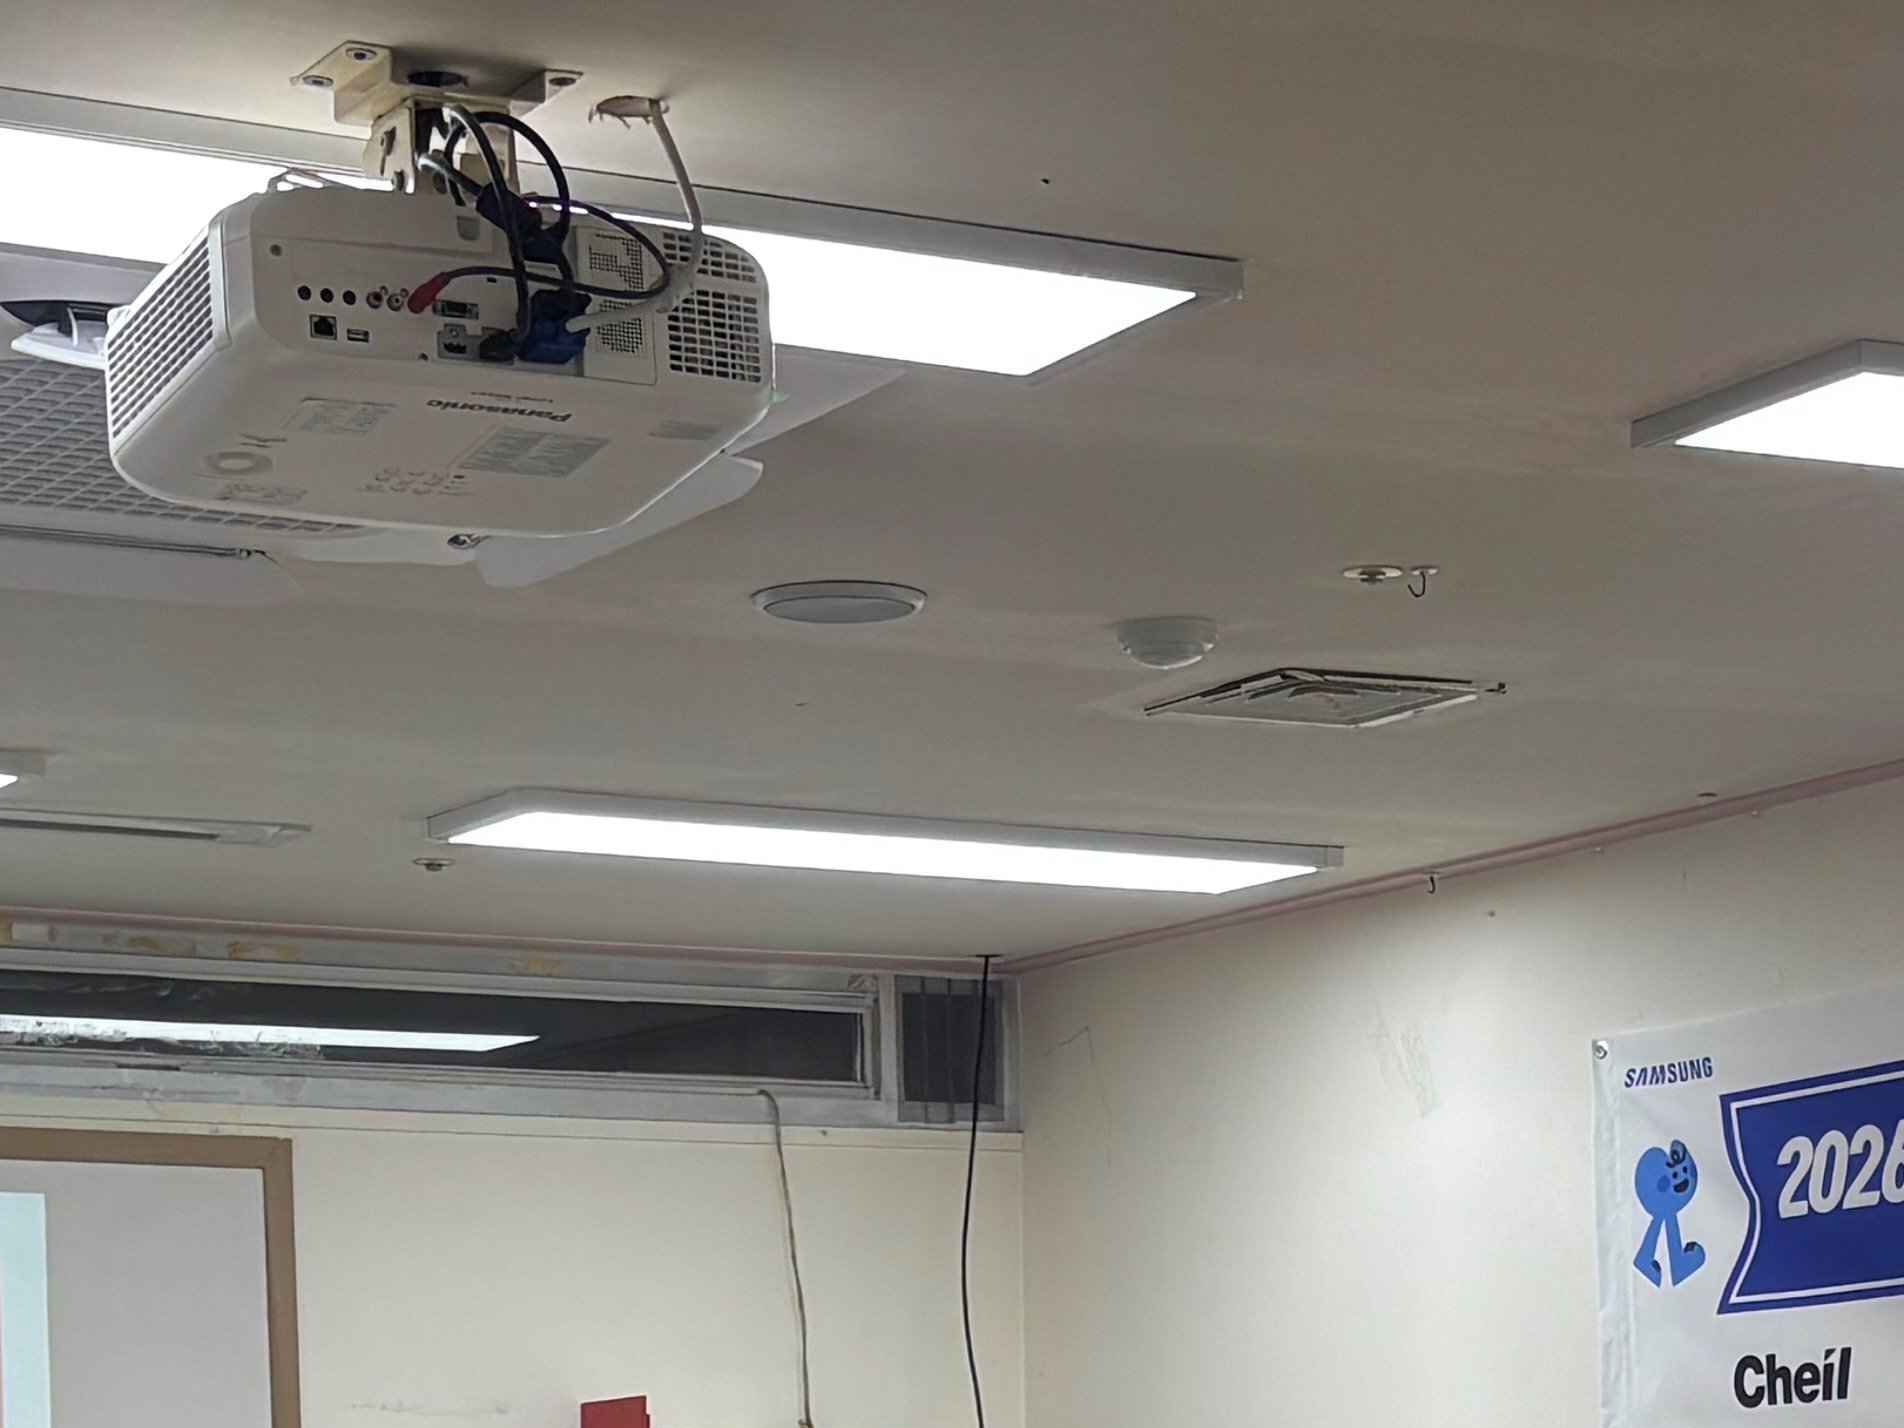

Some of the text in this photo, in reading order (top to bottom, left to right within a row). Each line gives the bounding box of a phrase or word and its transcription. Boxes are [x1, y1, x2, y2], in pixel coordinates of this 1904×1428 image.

[427, 399, 573, 423] Panasonic
[1624, 1056, 1713, 1088] SAMSUNG
[1733, 1346, 1852, 1409] Cheil
